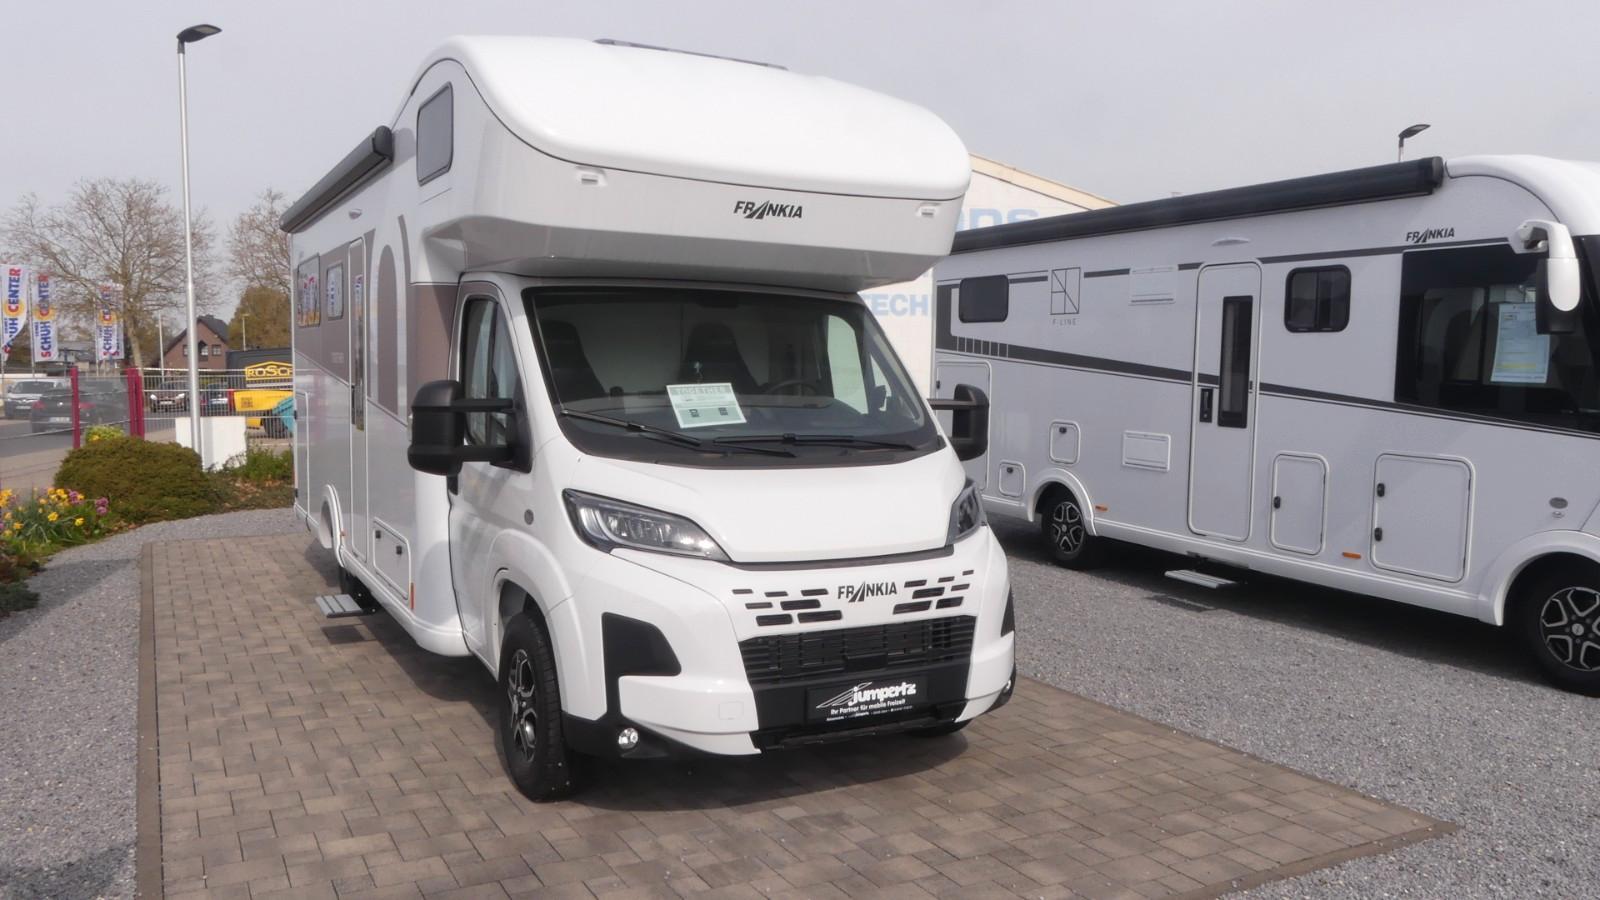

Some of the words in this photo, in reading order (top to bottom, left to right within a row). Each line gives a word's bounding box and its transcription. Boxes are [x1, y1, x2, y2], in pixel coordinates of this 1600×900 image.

[734, 200, 803, 219] FRANKIA
[1405, 227, 1455, 244] FRANKIA
[8, 268, 21, 313] CENTER
[40, 321, 52, 358] SCHUH
[838, 581, 898, 603] FRANKIA
[839, 705, 860, 714] Partner
